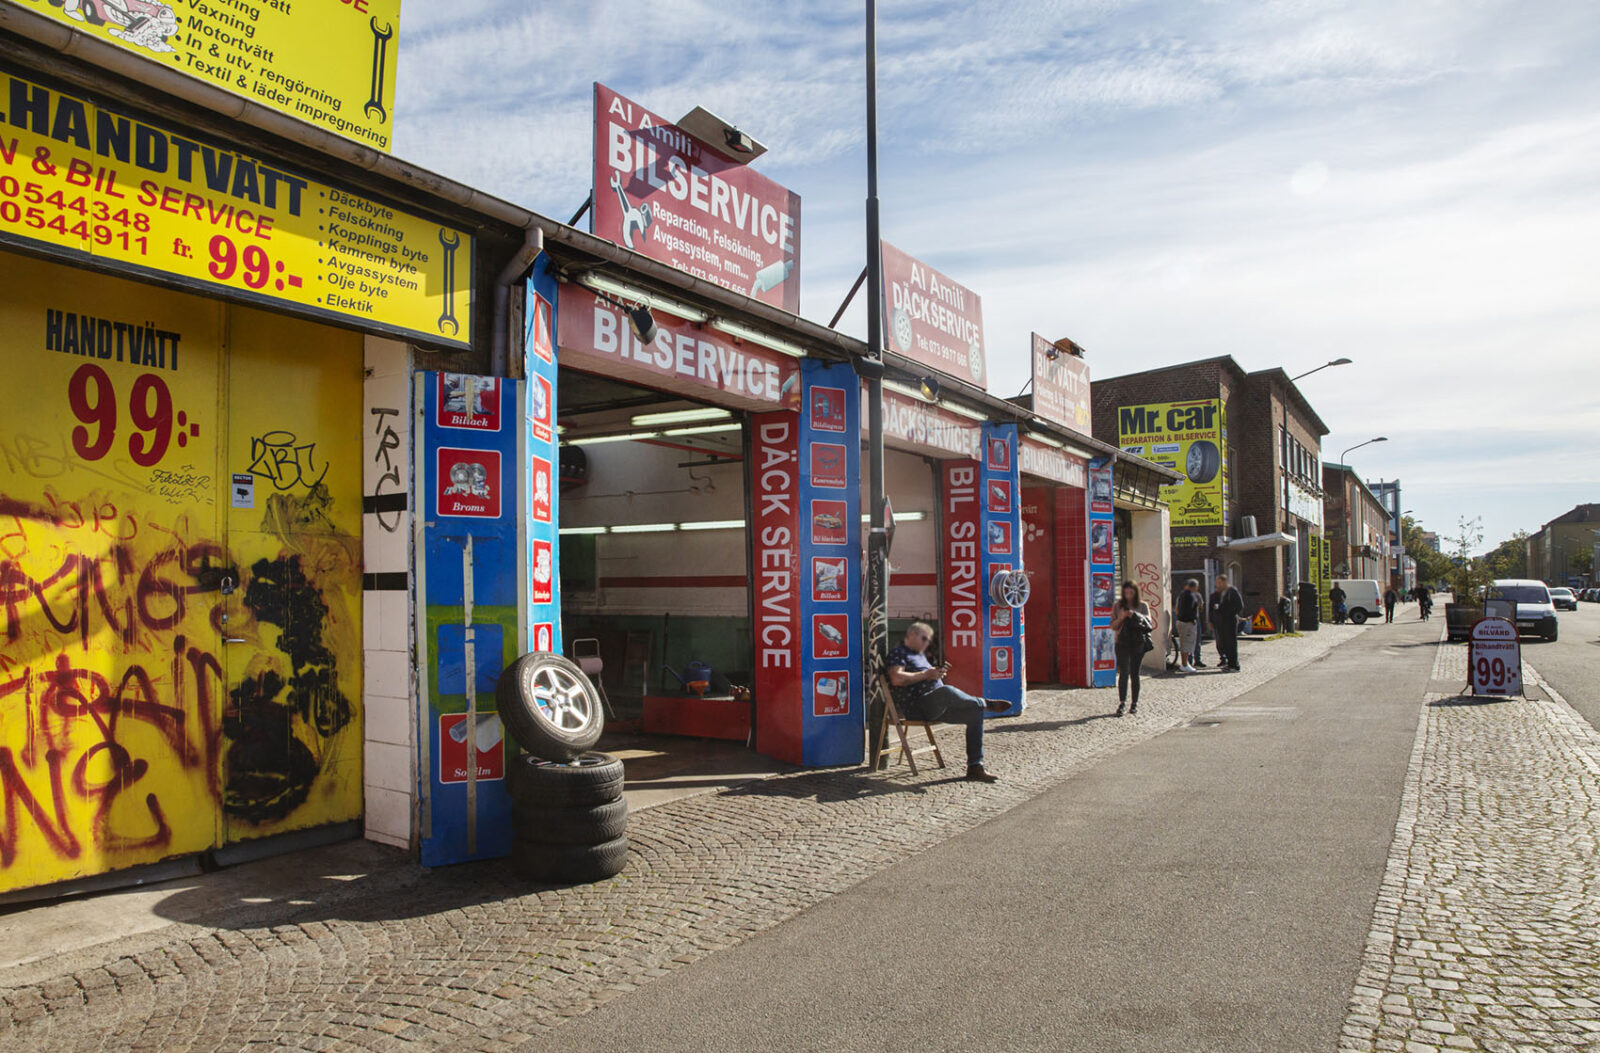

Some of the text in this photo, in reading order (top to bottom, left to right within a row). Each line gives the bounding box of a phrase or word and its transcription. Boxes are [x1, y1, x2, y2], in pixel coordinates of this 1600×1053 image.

[188, 16, 274, 63] Motortvätt
[186, 33, 342, 110] In & utv. rengörning
[186, 53, 388, 148] Textil & läder impregnering
[608, 96, 692, 158] Al Amili
[32, 146, 58, 176] &
[66, 158, 125, 199] BIL
[137, 180, 275, 240] SERVICE
[330, 190, 394, 220] Däckbyte
[608, 121, 794, 254] BILSERVICE
[328, 206, 404, 242] Felsökning
[328, 223, 428, 264] Kopplings byte
[652, 201, 764, 268] Reparation, Felsökning,
[172, 234, 303, 292] fr. 99:-
[328, 239, 418, 274] Kamrem byte
[653, 225, 722, 272] Avgassystem,
[328, 256, 418, 291] Avgassystem
[328, 273, 388, 298] Olje byte
[910, 262, 964, 312] Al Amili
[326, 294, 374, 313] Elektik
[892, 280, 980, 348] DÄCKSERVICE
[46, 308, 181, 371] HANDTVÄTT
[594, 306, 780, 402] BILSERVICE
[1120, 404, 1217, 435] Mr. car
[1121, 431, 1216, 445] REPARATION & BILSERVICE
[452, 502, 485, 512] Broms
[760, 422, 797, 668] DÄCK SERVICE
[950, 466, 977, 648] BIL SERVICE
[454, 766, 492, 778] Solm
